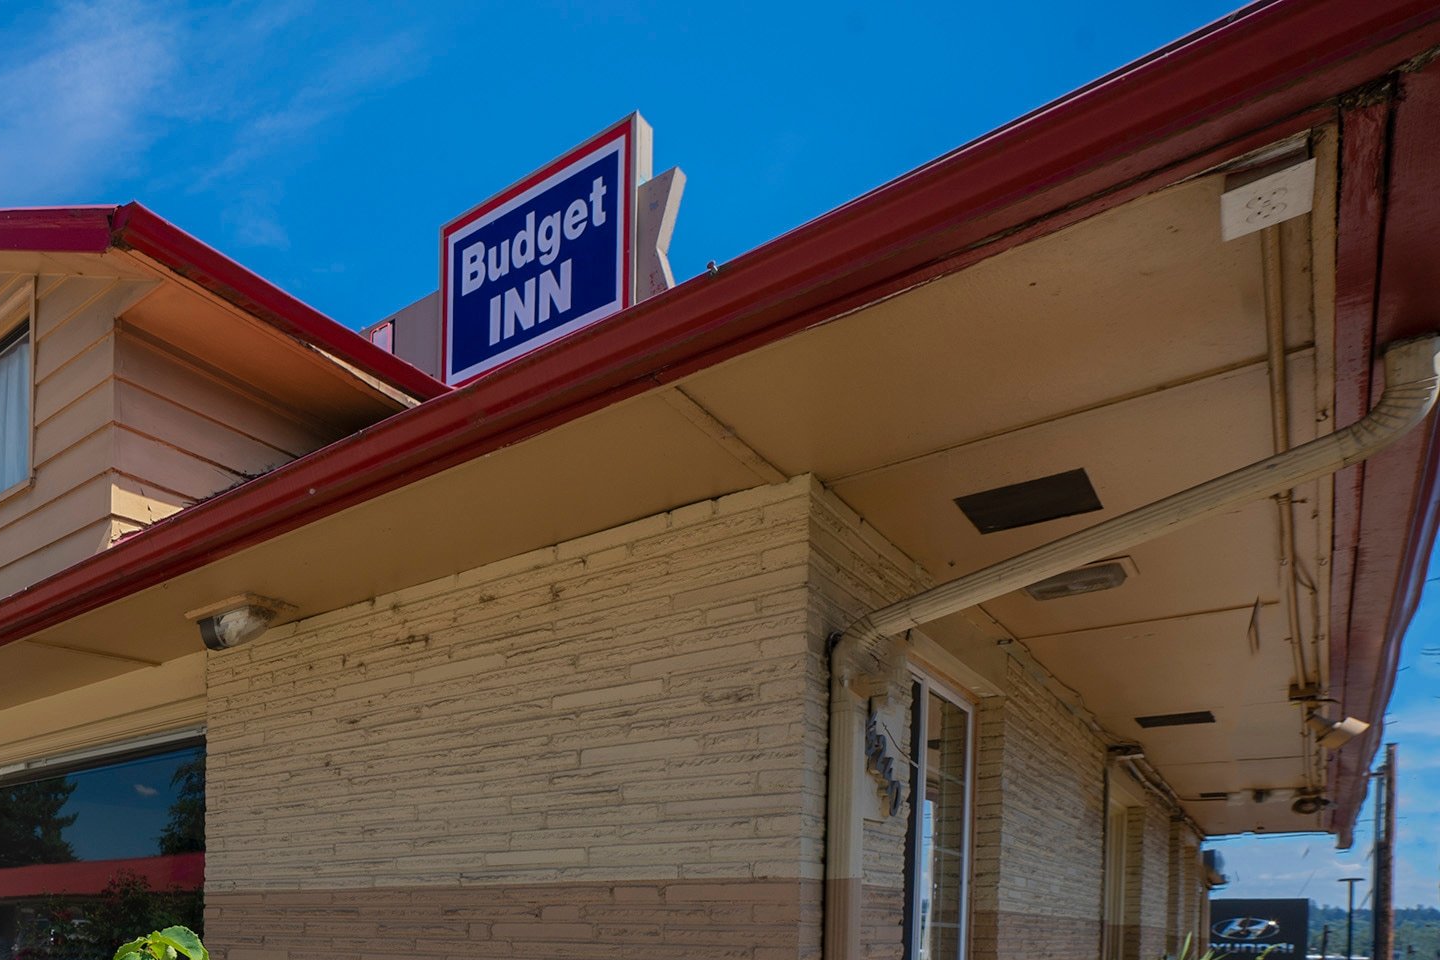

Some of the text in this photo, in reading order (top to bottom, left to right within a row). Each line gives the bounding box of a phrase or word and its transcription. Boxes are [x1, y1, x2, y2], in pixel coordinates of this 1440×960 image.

[461, 176, 607, 296] Budget
[489, 258, 573, 346] INN
[1209, 942, 1295, 954] YUNDAI
